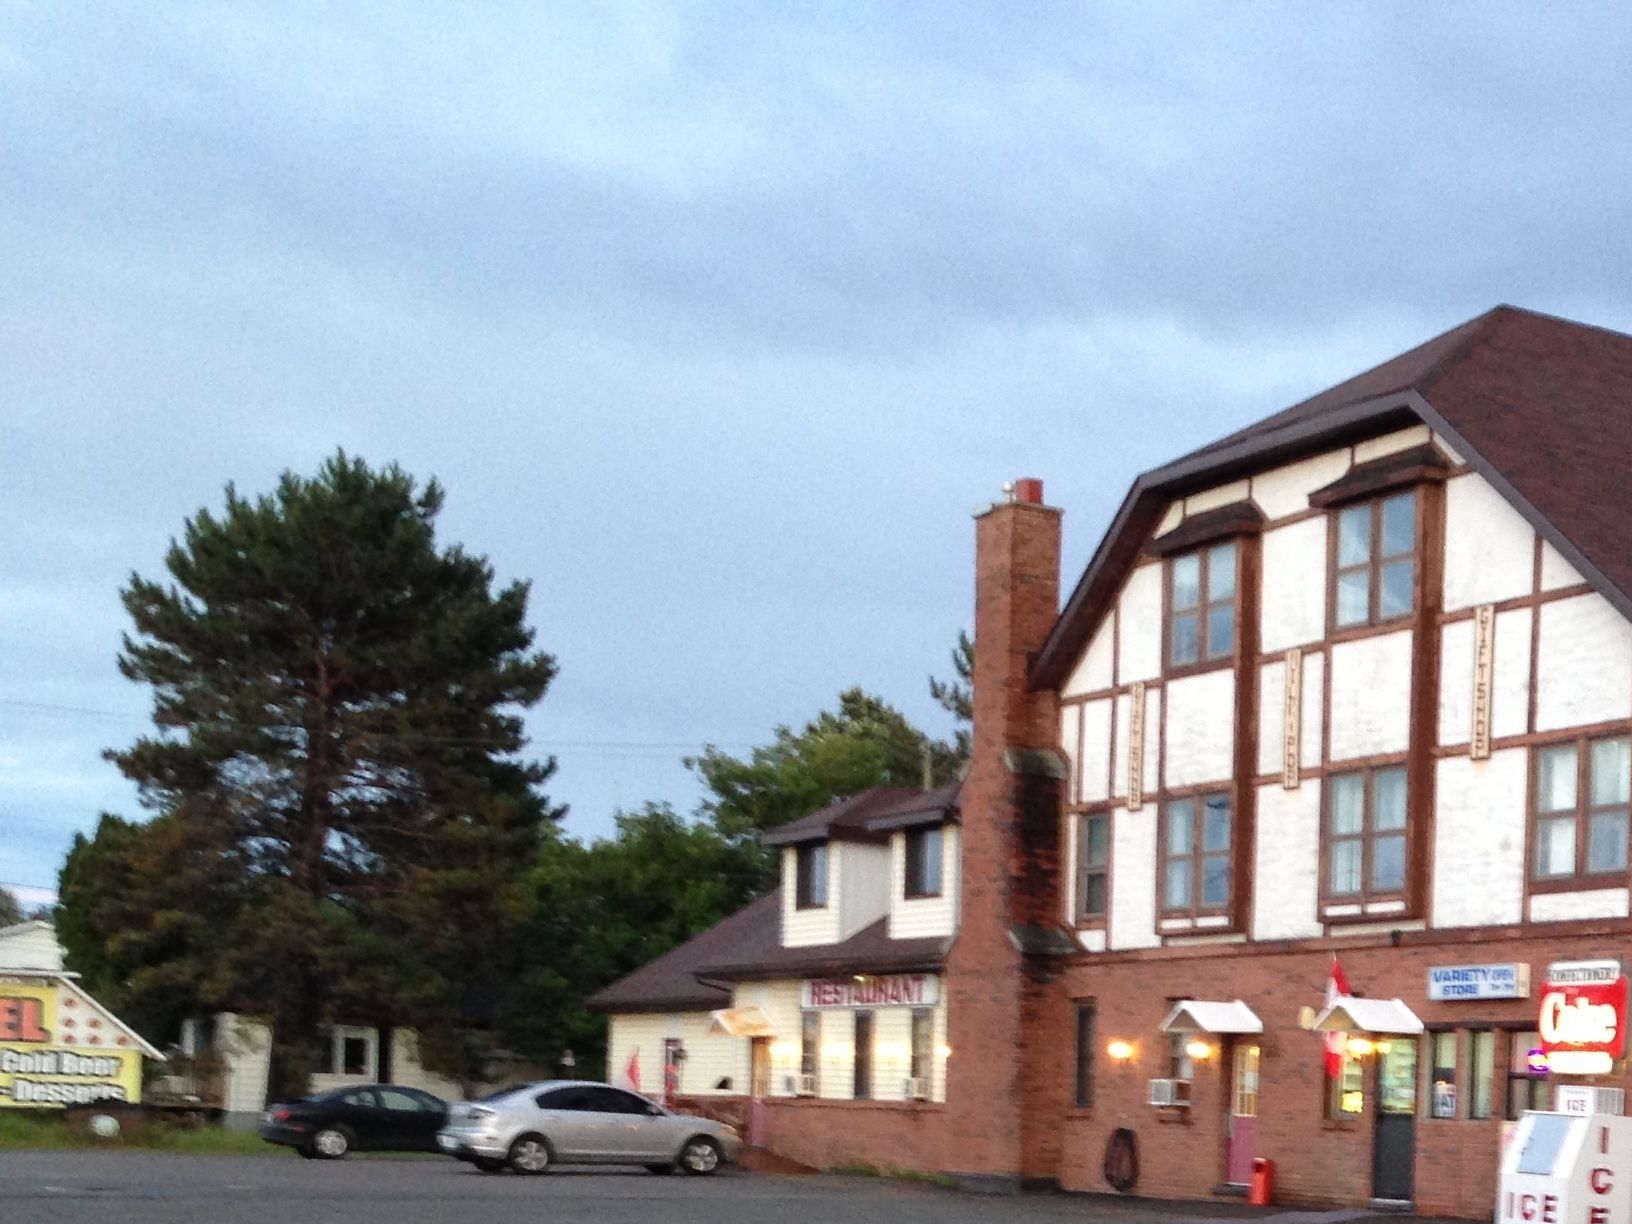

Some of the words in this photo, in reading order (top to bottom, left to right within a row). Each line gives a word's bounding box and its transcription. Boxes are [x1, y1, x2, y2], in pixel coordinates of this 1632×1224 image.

[1433, 968, 1488, 983] VARIETY
[1551, 967, 1617, 982] CONFECTIONERY
[811, 974, 927, 1005] RESTAURANT
[1442, 984, 1477, 995] STORE
[1539, 991, 1618, 1044] Coke
[1567, 1099, 1587, 1112] ICE
[1504, 1191, 1559, 1224] ICE
